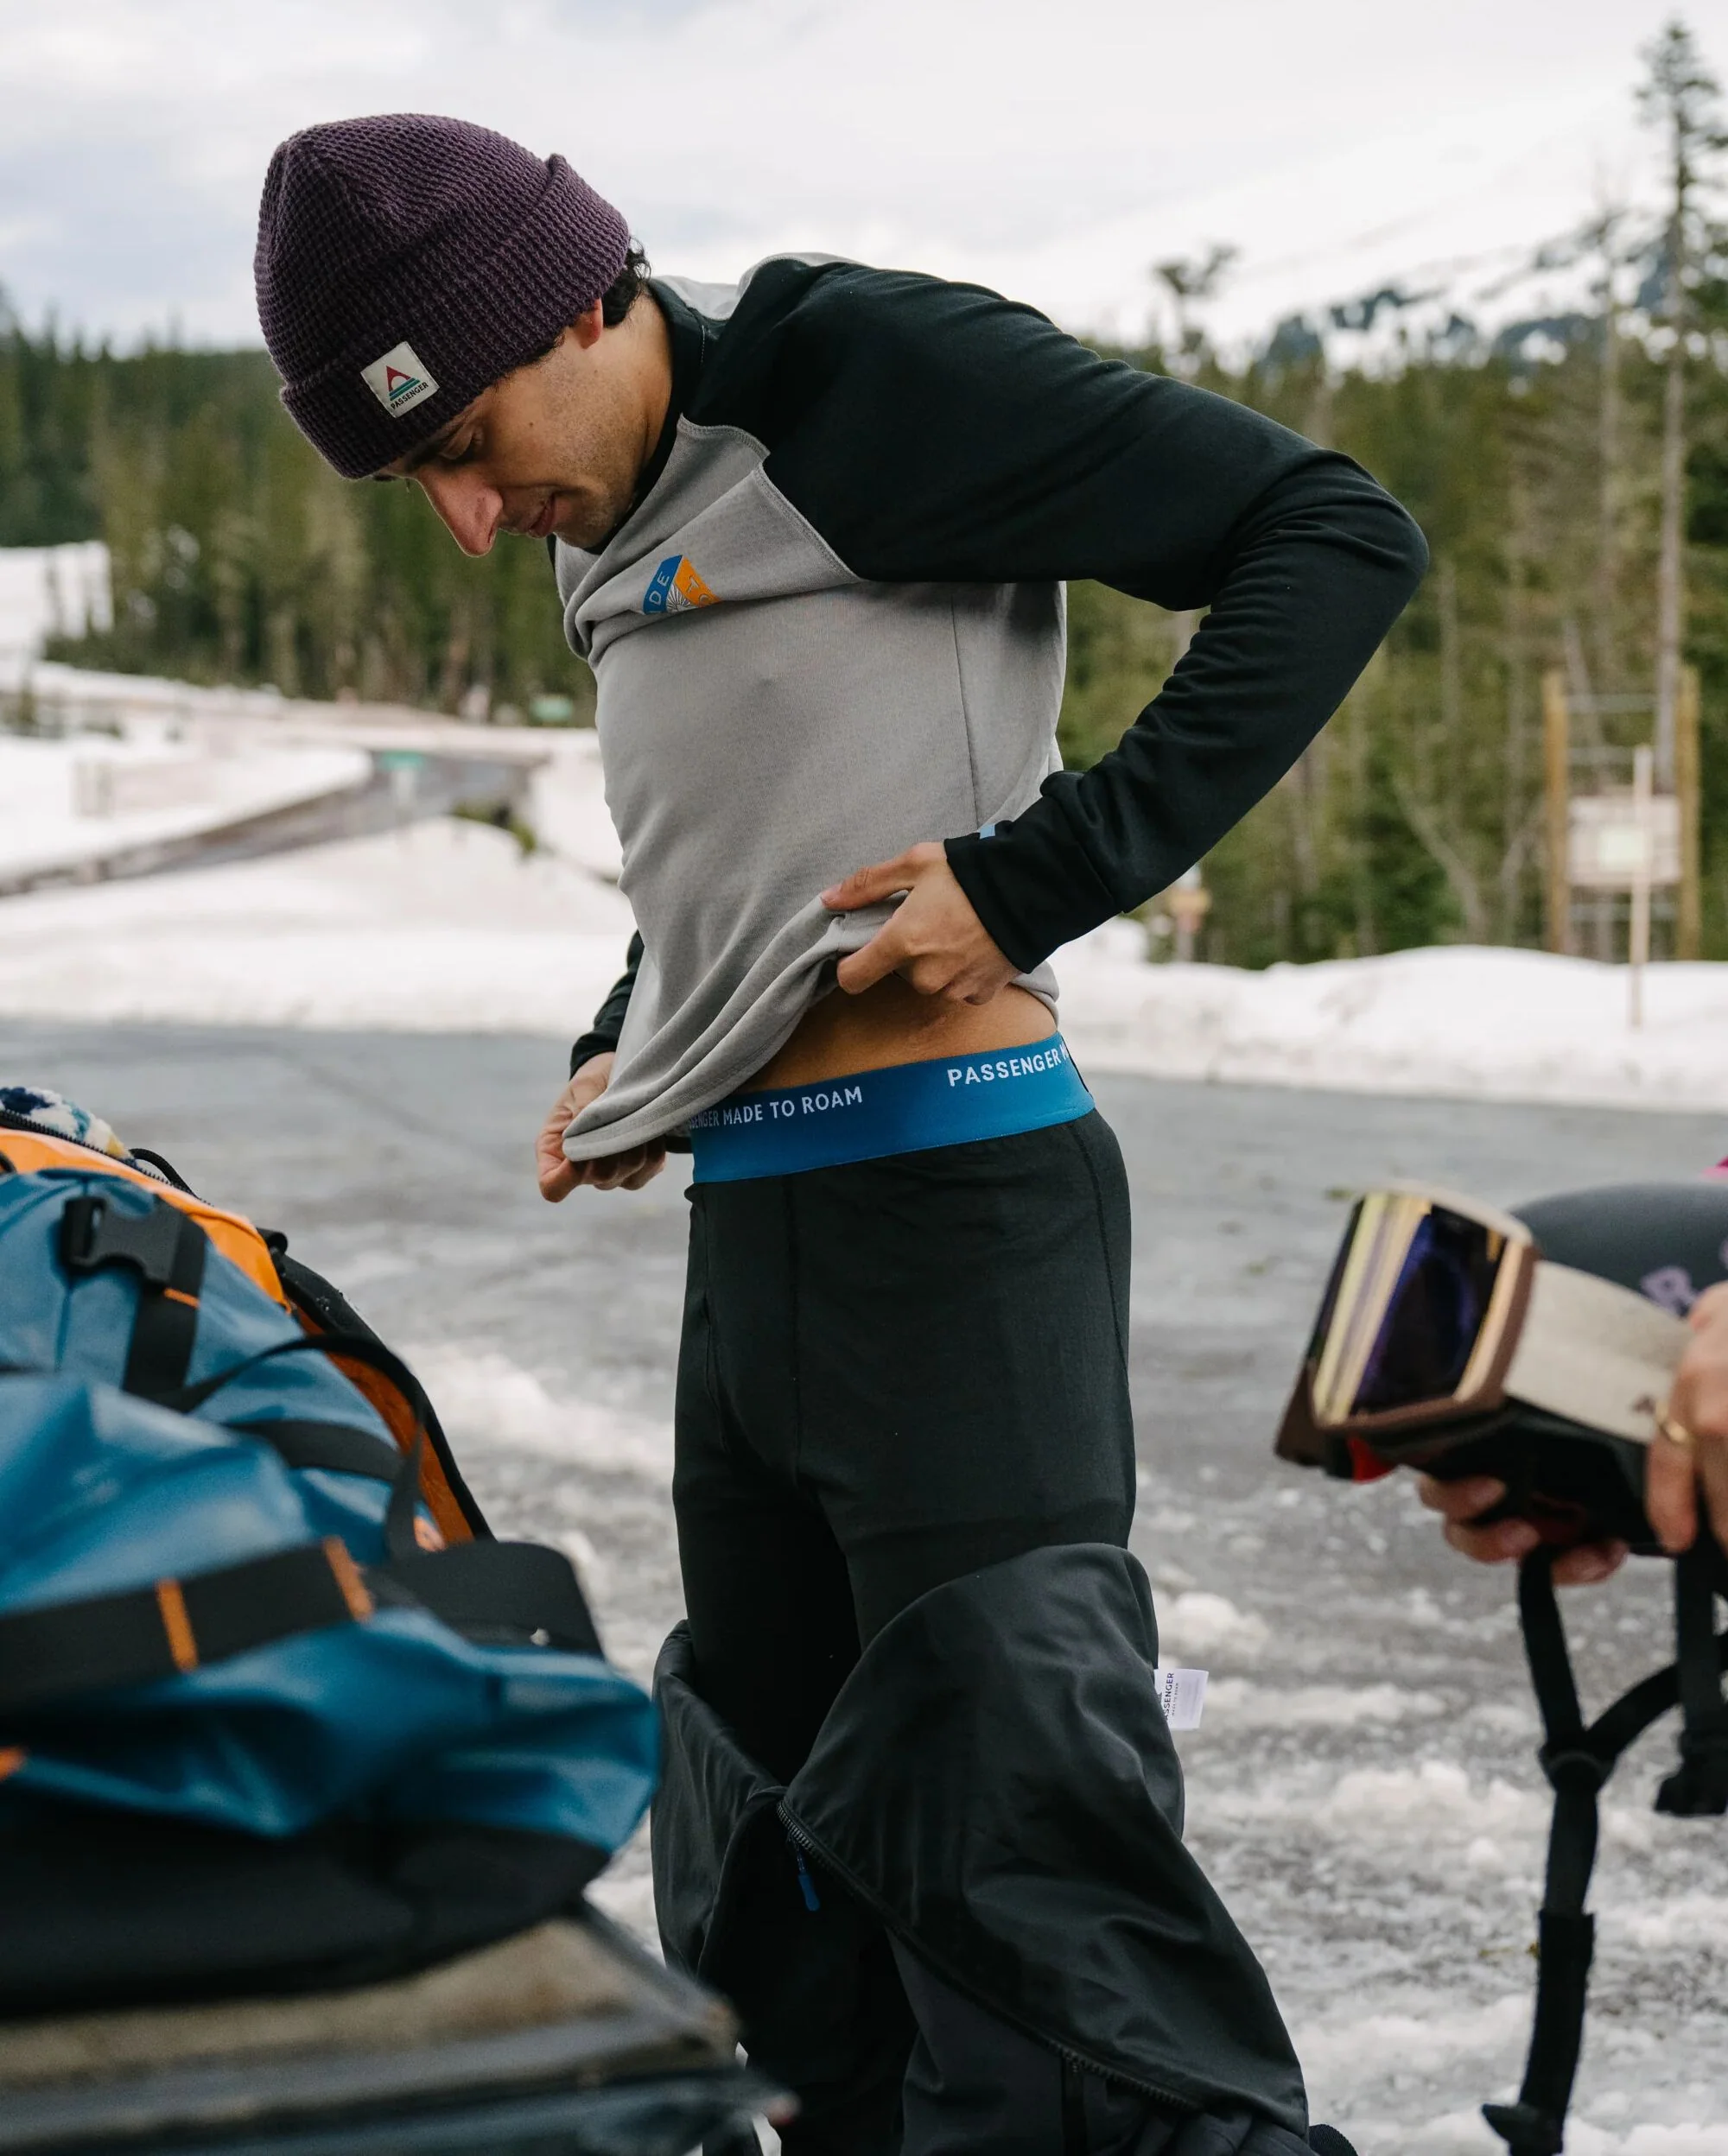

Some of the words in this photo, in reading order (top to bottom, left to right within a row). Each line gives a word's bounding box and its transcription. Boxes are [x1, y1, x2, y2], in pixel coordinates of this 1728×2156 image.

[391, 382, 429, 409] PASSENGER
[648, 571, 670, 606] DE
[947, 1048, 1062, 1087] PASSENGER
[723, 1104, 763, 1126] MADE
[770, 1100, 795, 1119] TO
[802, 1086, 862, 1114] ROAM
[1163, 1672, 1174, 1721] ASSENGER
